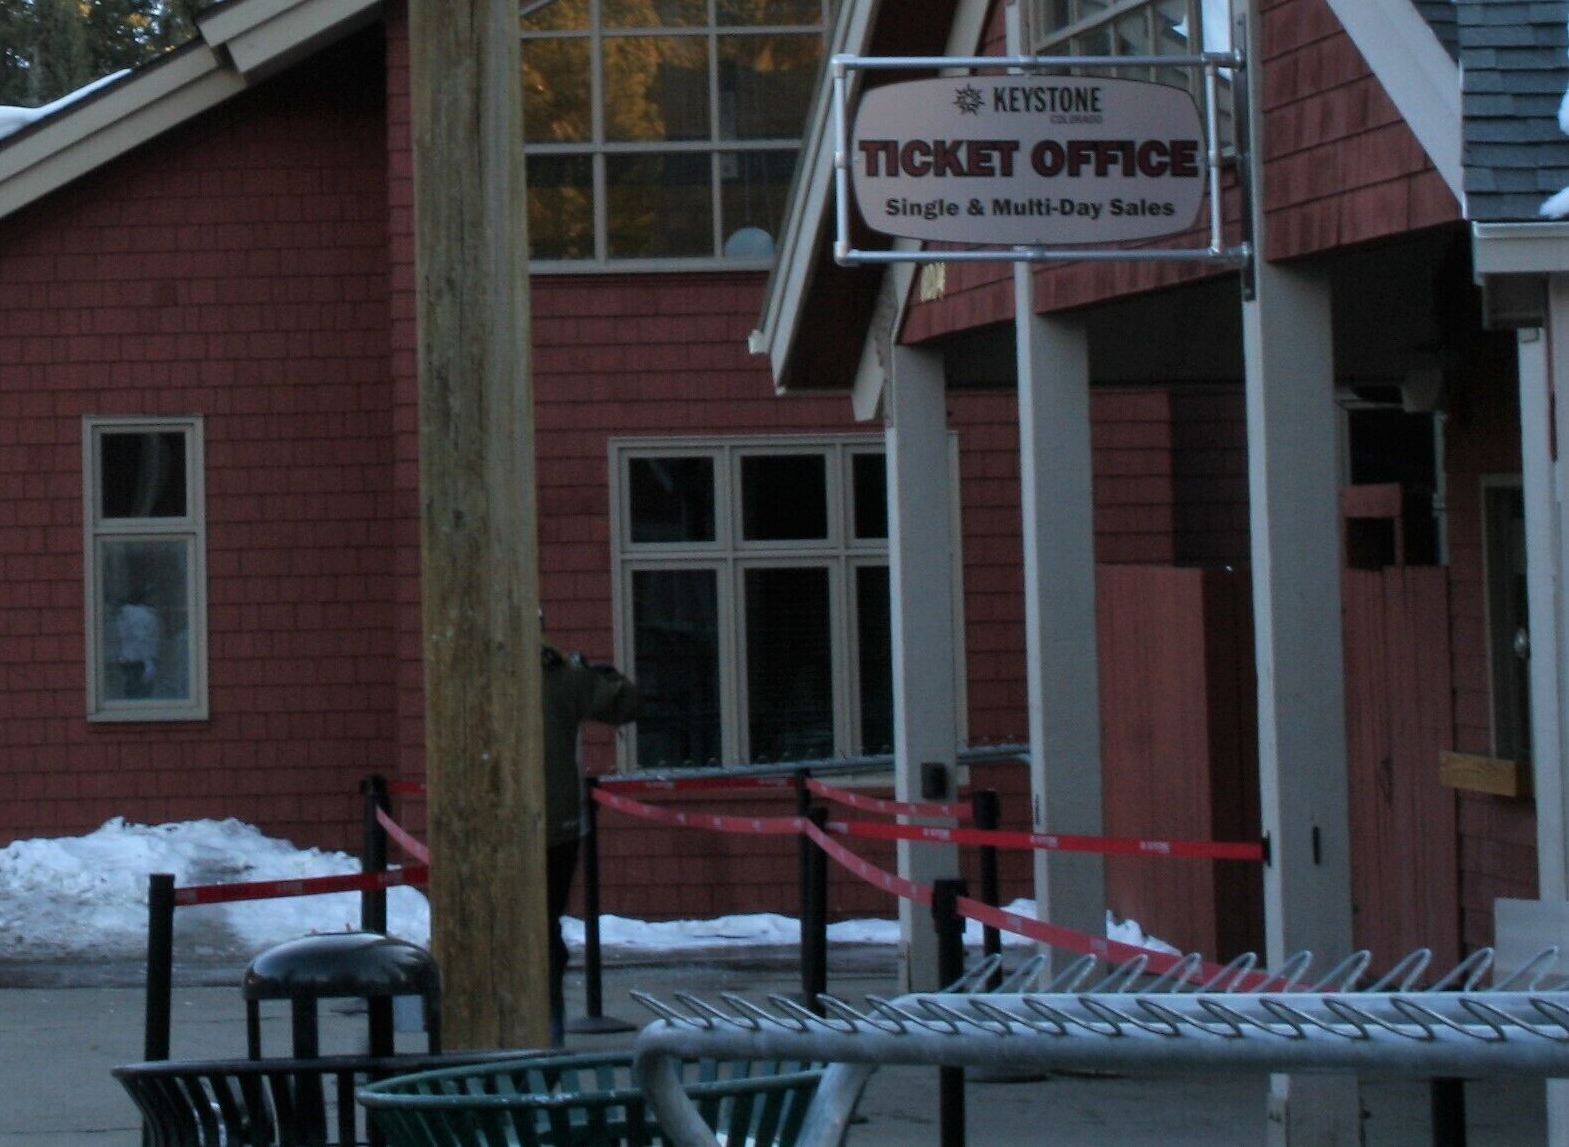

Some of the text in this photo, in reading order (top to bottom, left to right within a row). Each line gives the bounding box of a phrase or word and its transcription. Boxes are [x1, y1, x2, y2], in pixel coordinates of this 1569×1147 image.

[993, 85, 1103, 113] KEYSTONE
[858, 139, 1200, 178] TICKET OFFICE
[885, 198, 1176, 220] Single & Multi-Day Sales
